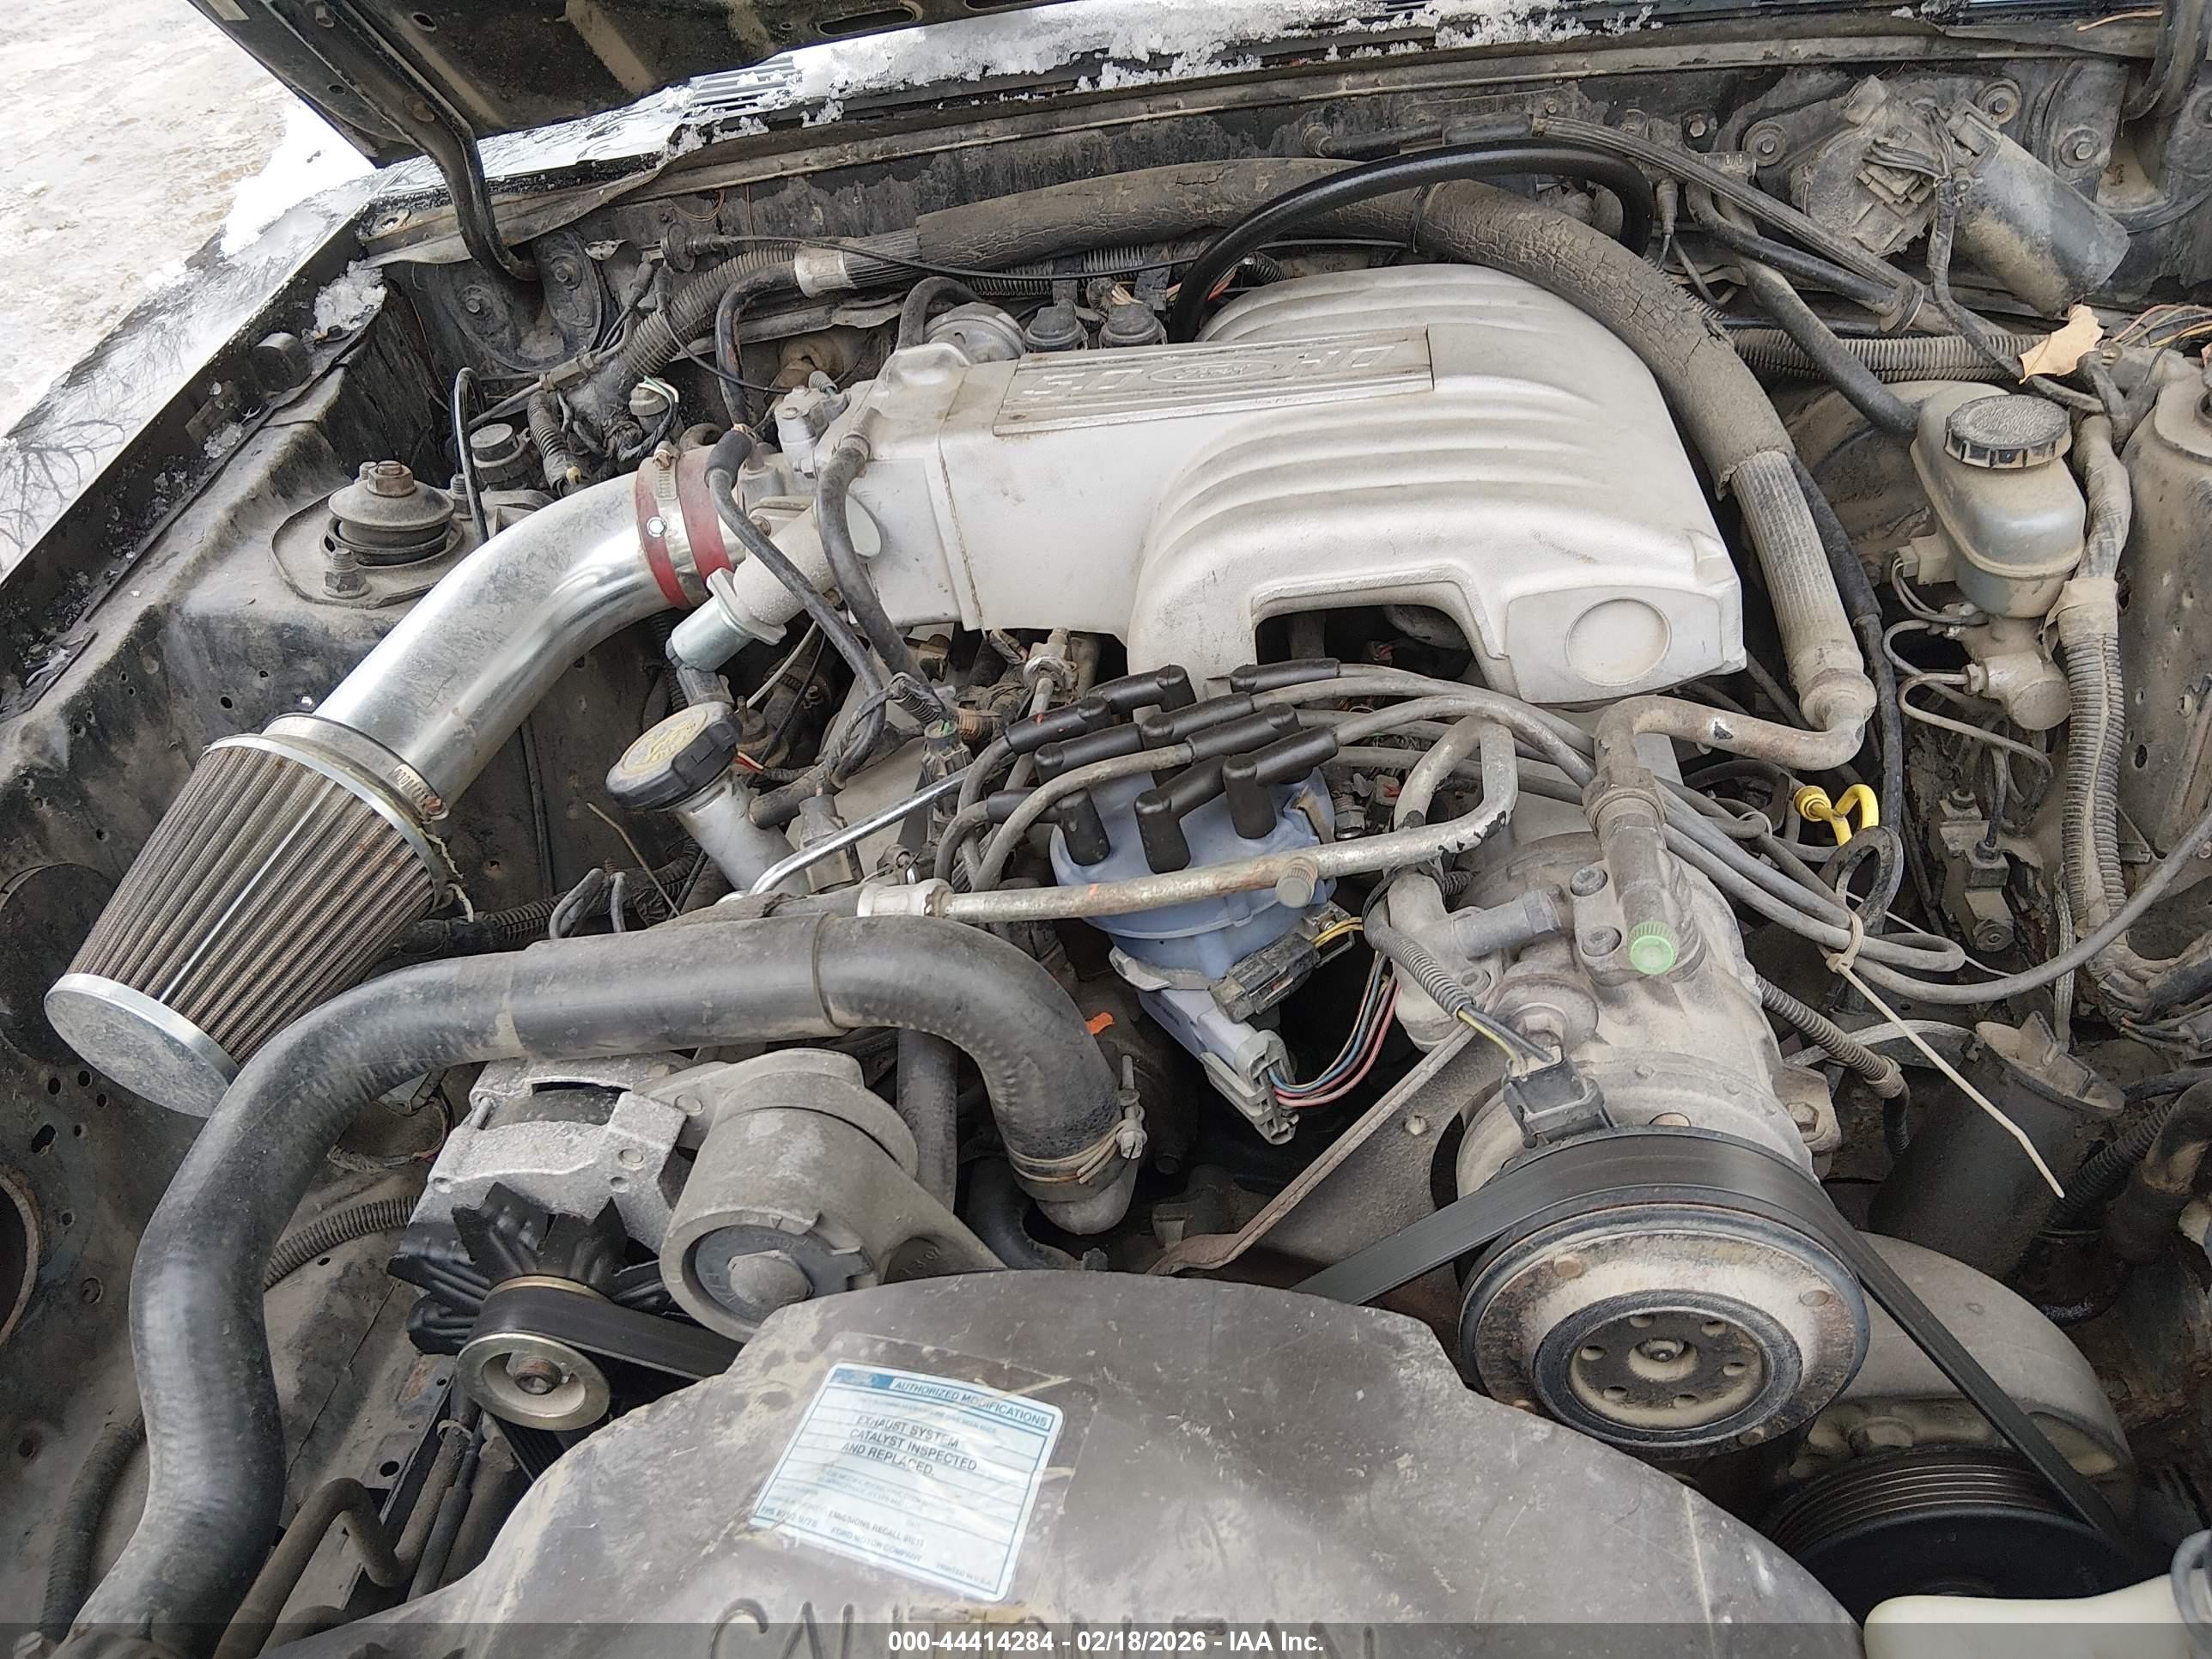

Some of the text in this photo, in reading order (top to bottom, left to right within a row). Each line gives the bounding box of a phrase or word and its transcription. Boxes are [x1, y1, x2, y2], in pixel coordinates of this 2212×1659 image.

[893, 1381, 959, 1401] AUTHORIZED
[961, 1393, 1048, 1427] MODIFICATIONS
[848, 1427, 978, 1471] CATALYST INSPECTED
[856, 1416, 960, 1448] EXHAUST SYSTEM
[841, 1441, 935, 1477] AND REPLACED.
